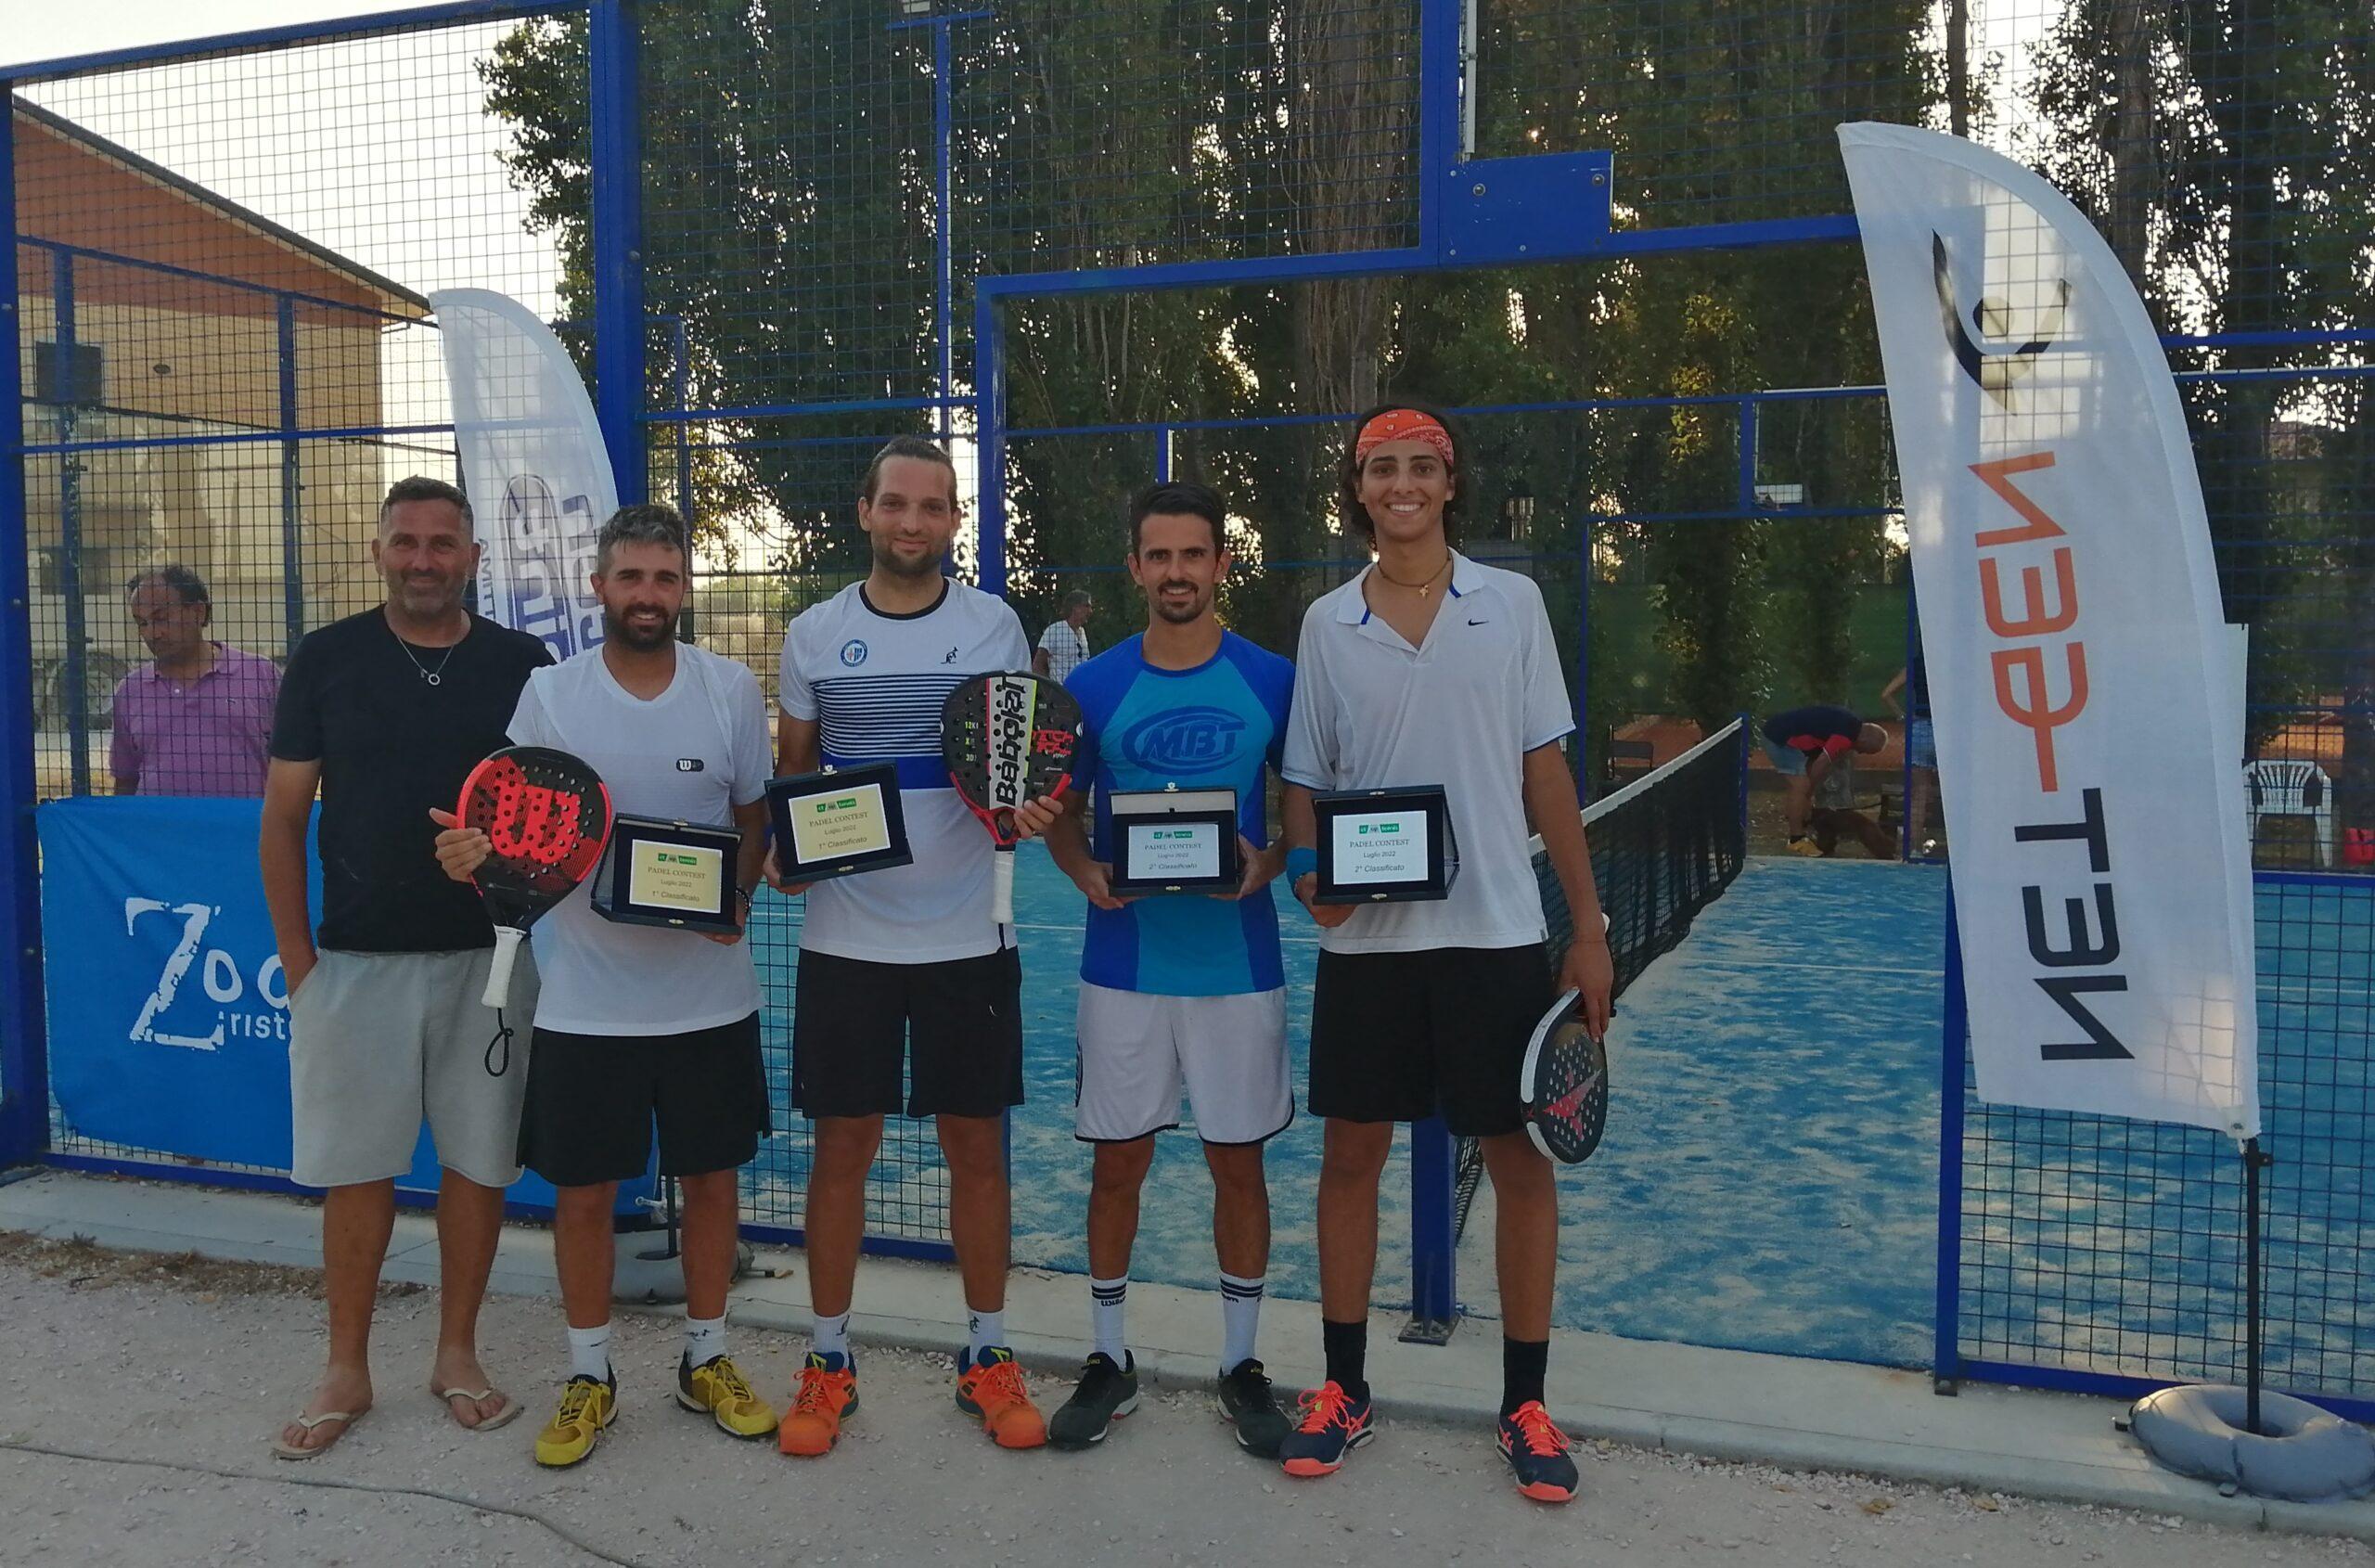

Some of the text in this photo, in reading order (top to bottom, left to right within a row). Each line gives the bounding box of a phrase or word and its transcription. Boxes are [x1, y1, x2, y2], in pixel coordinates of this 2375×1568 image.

[995, 676, 1026, 806] Babolat
[1139, 721, 1247, 759] MBT
[809, 812, 867, 827] PADEL CONTEST
[828, 837, 867, 848] Classificato
[673, 869, 705, 879] CONTEST
[230, 1011, 290, 1040] rist
